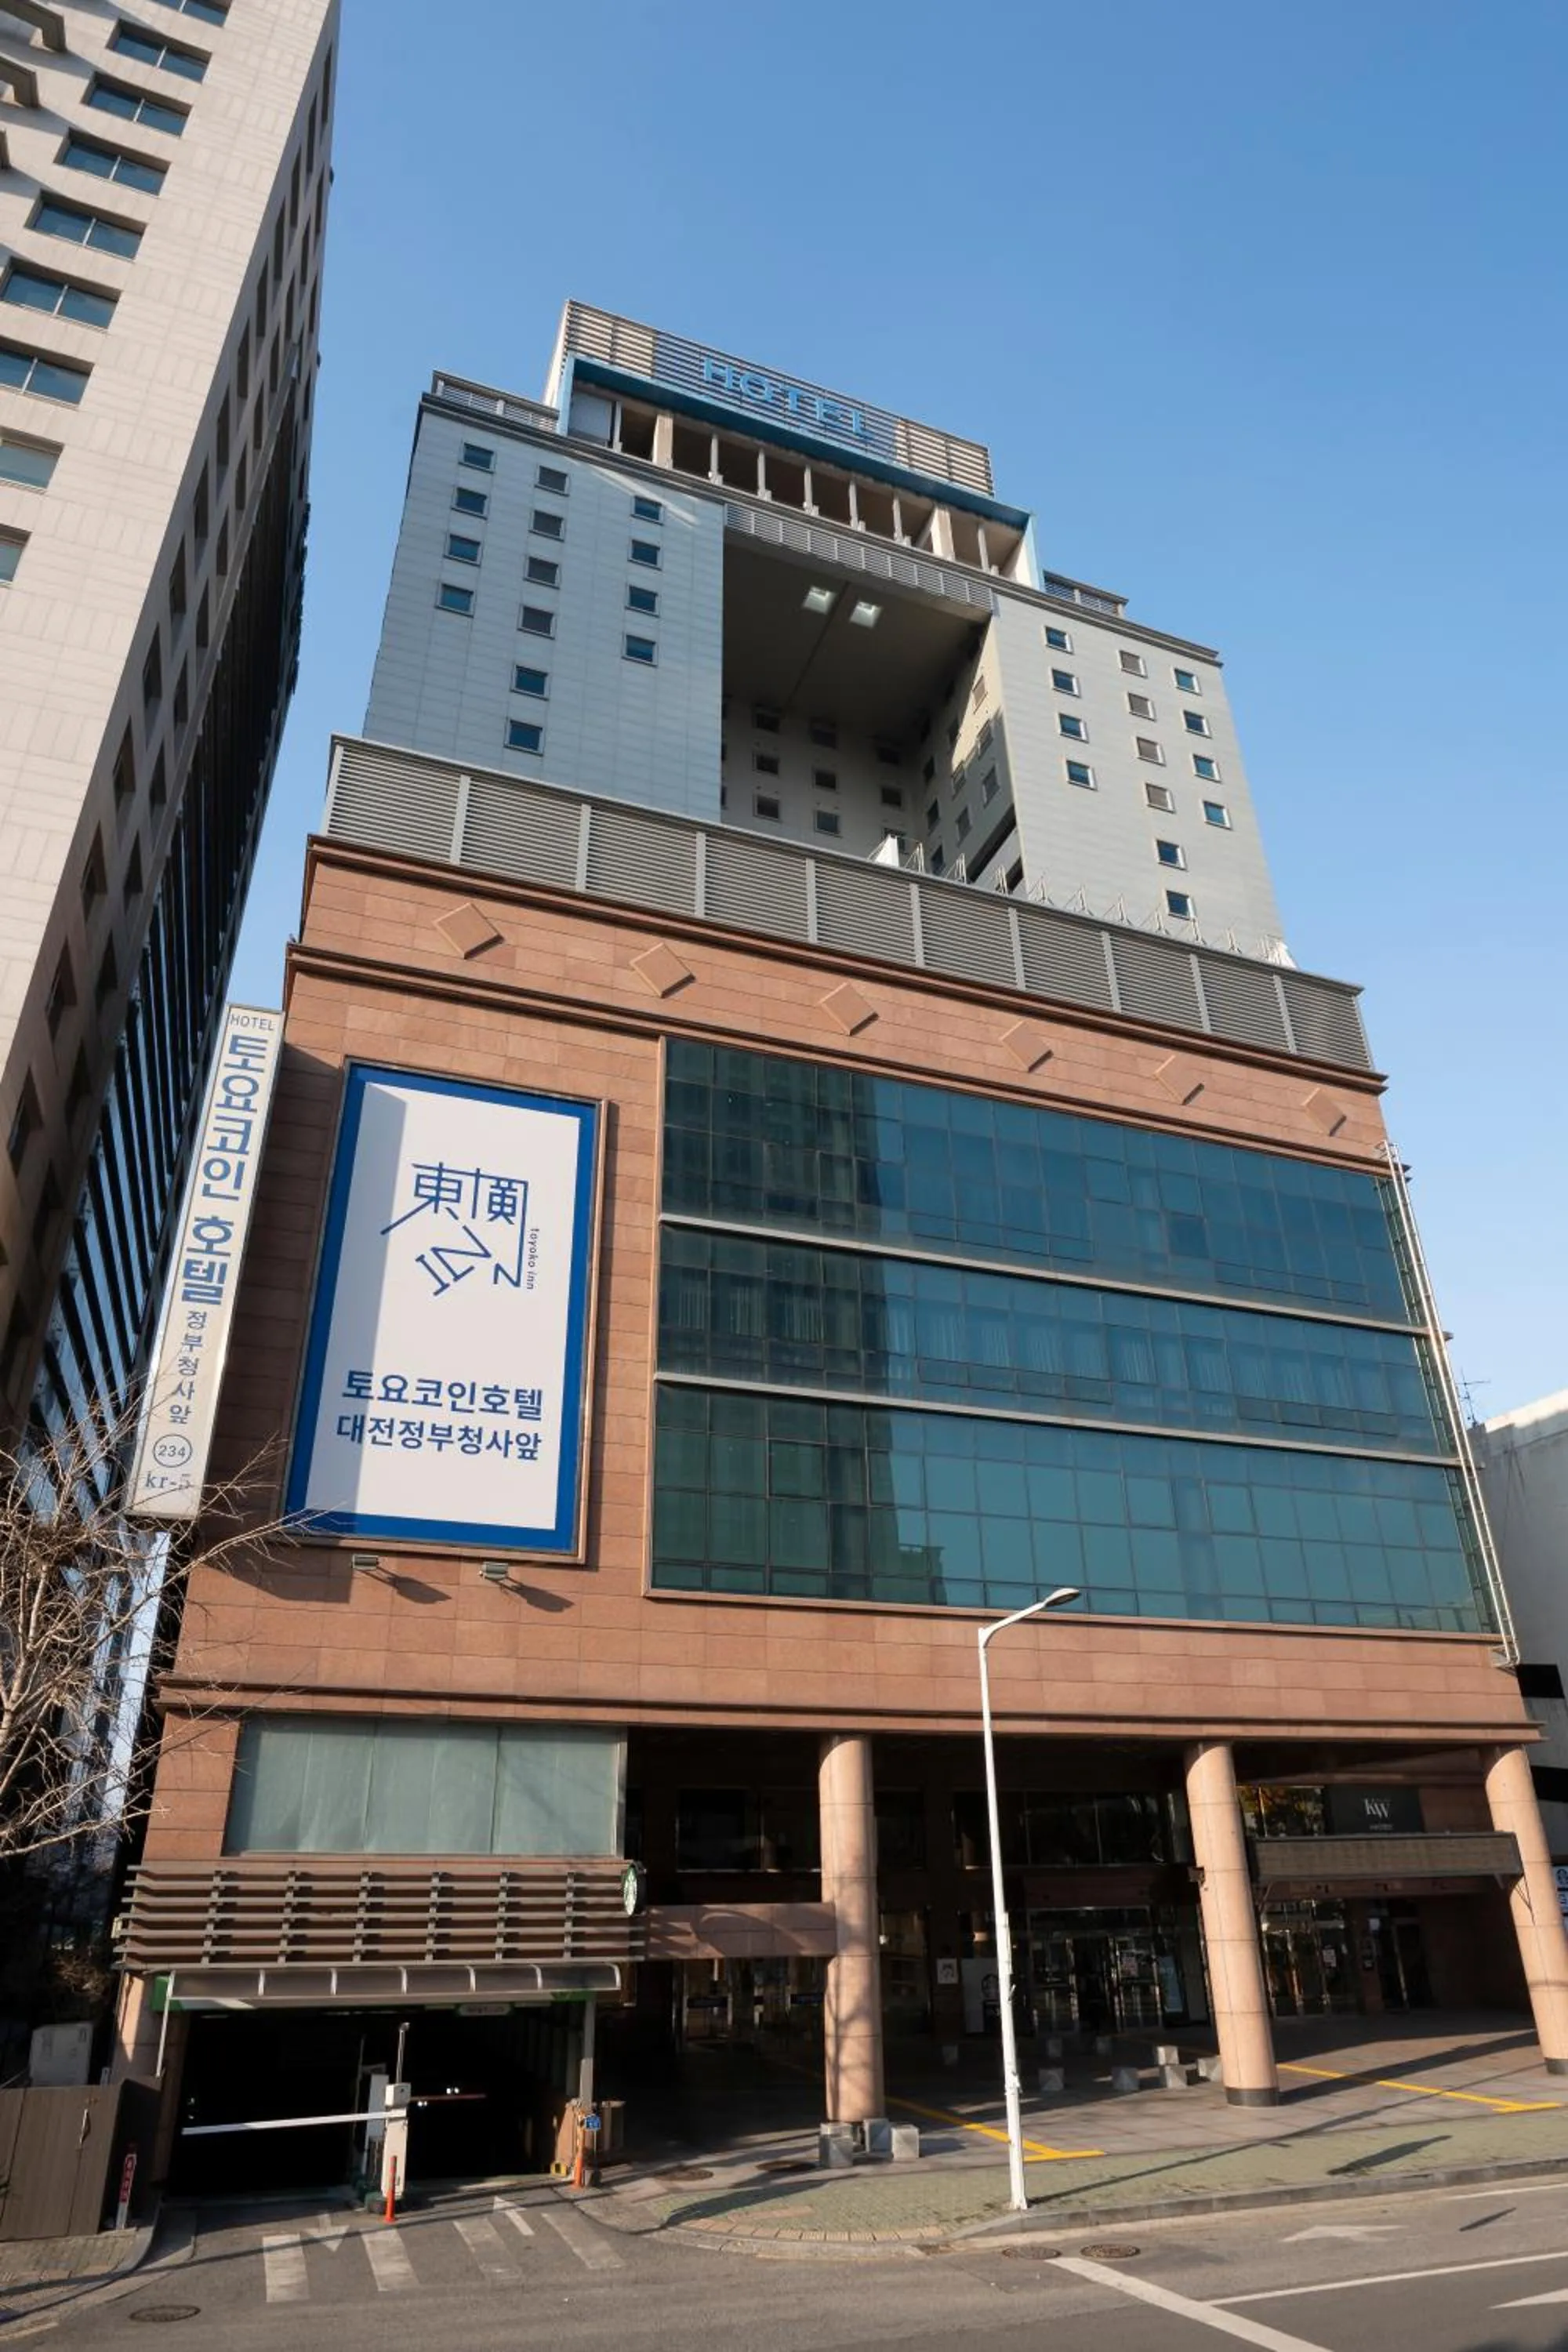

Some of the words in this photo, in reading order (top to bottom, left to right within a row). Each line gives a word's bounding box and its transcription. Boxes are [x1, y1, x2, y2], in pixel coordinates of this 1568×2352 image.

[702, 357, 875, 443] HOTEL
[229, 1014, 274, 1032] HOTEL
[201, 1033, 268, 1201] 토요코인
[180, 1215, 235, 1305] 호텔
[526, 1228, 540, 1269] toyoko
[525, 1271, 538, 1290] inn
[169, 1310, 208, 1425] 정부청사앞
[342, 1369, 543, 1422] 토요코인호텔
[158, 1444, 187, 1458] 234
[336, 1414, 543, 1461] 대전정부청사앞
